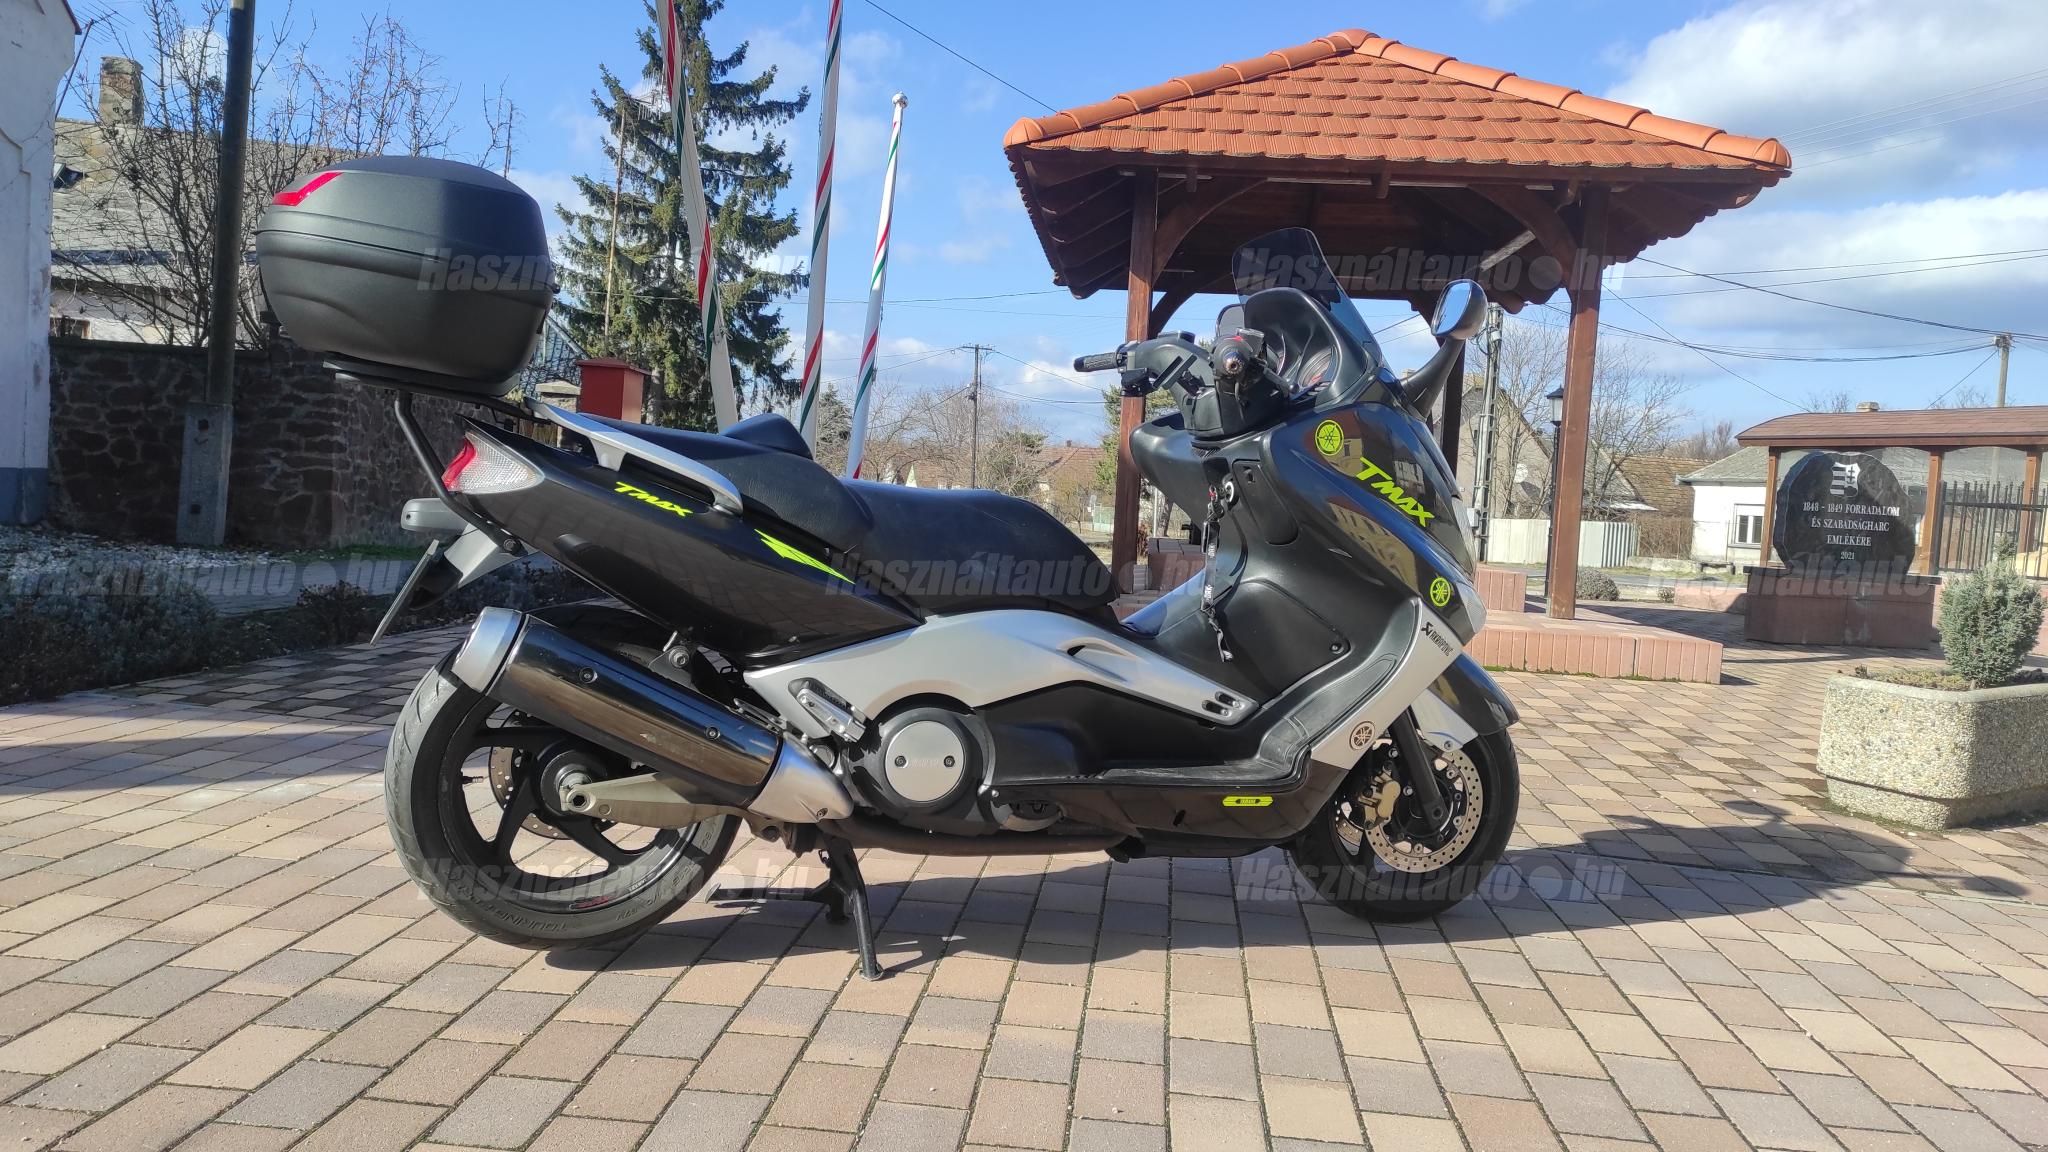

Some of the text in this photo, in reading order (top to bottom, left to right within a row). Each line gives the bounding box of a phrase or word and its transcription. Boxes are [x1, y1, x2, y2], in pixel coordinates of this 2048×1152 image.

[614, 481, 693, 517] TMAX
[1356, 456, 1435, 527] TMAX
[1803, 502, 1819, 511] 1848
[1828, 503, 1843, 514] 1849
[1845, 504, 1900, 517] FORRADALOM
[1811, 516, 1890, 532] ÉS SZABADSÁGHARC
[1827, 533, 1872, 547] EMLÉKÉRE
[1840, 552, 1855, 560] 2021
